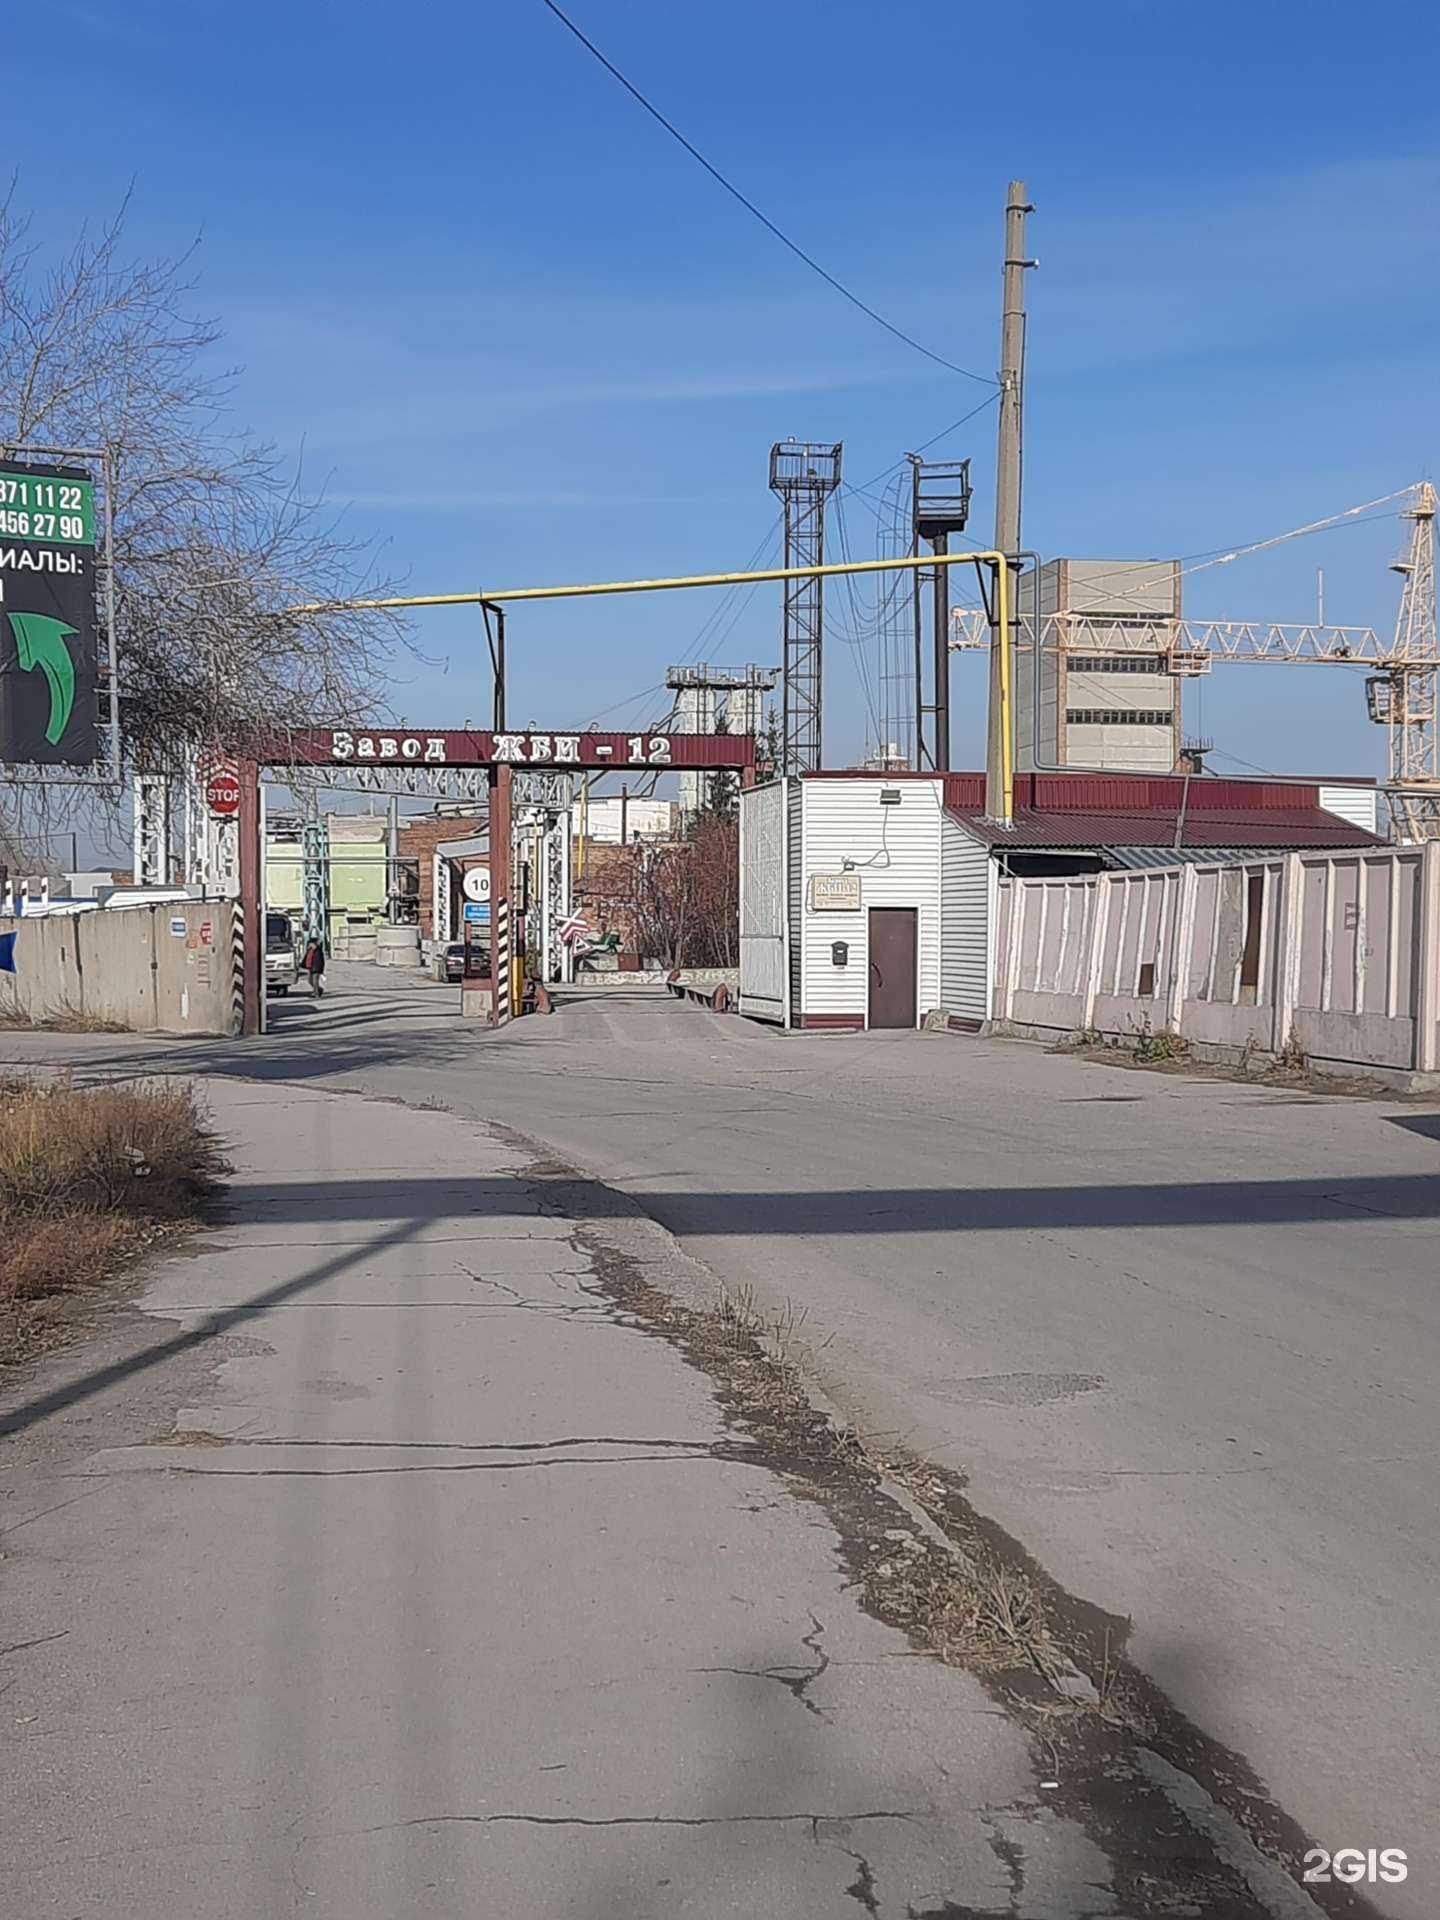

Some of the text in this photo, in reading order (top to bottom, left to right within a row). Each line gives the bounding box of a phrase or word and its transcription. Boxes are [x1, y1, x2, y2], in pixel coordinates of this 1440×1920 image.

[35, 483, 54, 507] 11
[59, 486, 82, 510] 22
[33, 513, 55, 537] 27
[60, 516, 83, 540] 90
[491, 735, 581, 762] ЖБИ
[628, 737, 672, 763] 12
[471, 879, 489, 891] 10
